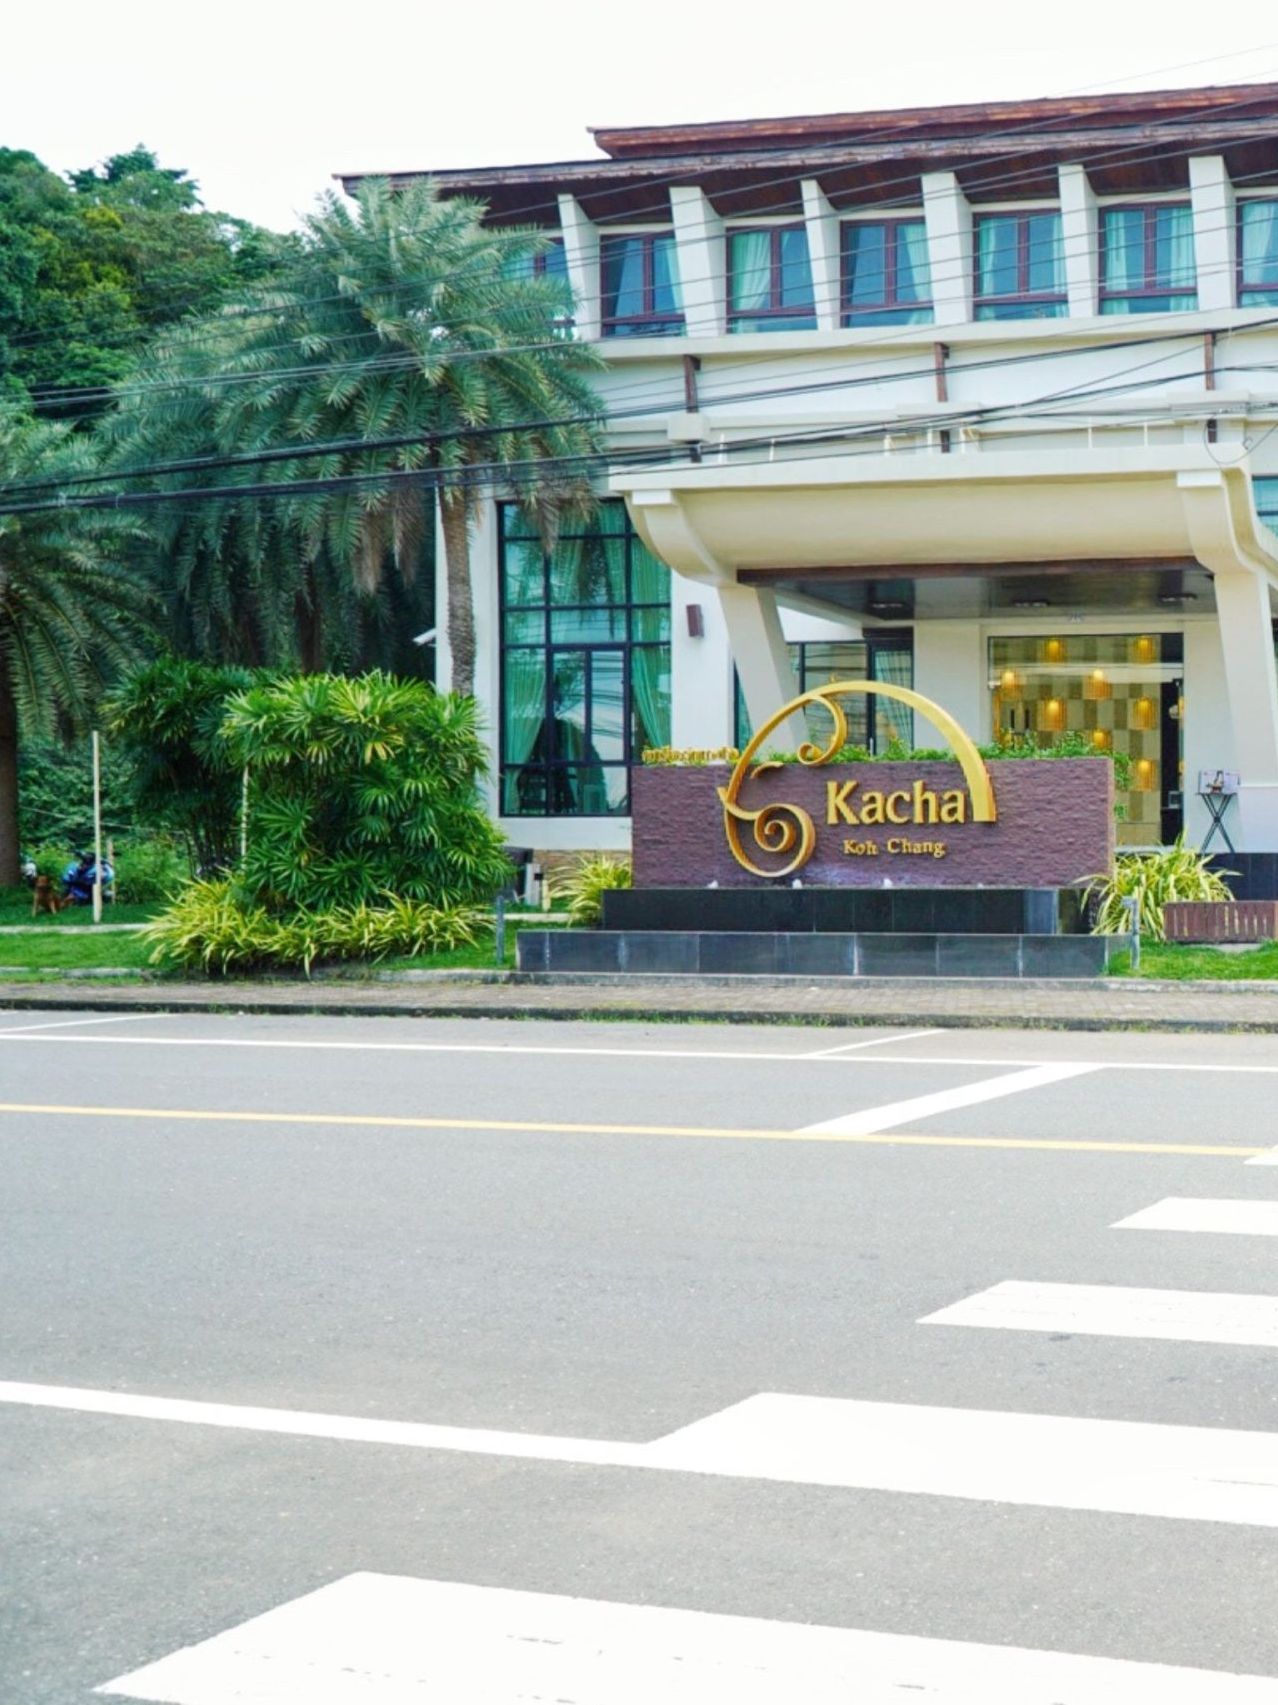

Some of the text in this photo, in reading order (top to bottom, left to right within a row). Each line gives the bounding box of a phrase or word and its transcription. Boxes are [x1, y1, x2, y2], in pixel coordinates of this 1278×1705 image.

[826, 780, 965, 825] Kacha
[843, 837, 946, 858] Koh Chang
